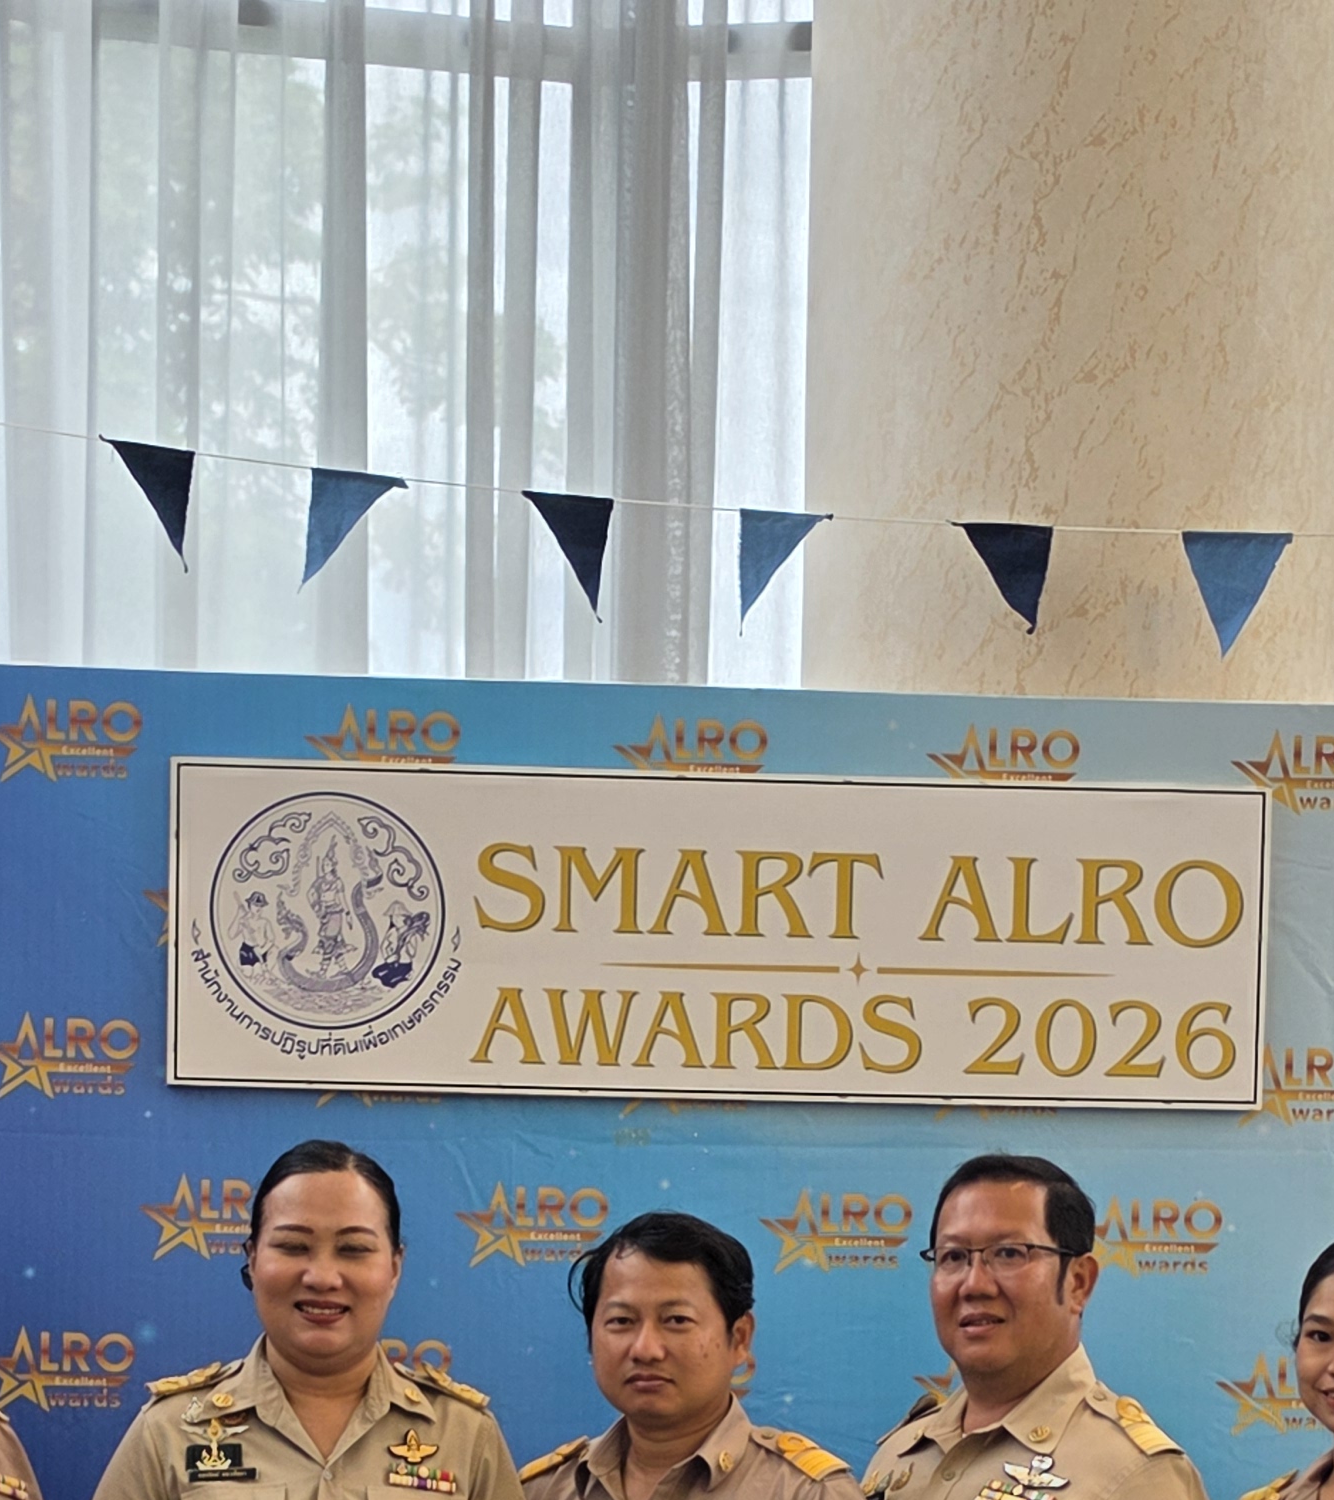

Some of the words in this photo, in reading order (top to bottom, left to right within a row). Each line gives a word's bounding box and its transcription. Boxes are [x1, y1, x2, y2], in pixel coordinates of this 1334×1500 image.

[61, 746, 115, 756] Excellent
[309, 704, 460, 753] ALRO
[617, 714, 768, 762] ALRO
[931, 723, 1080, 770] ALRO
[473, 842, 884, 938] SMART
[917, 855, 1245, 949] ALRO
[191, 948, 462, 1060] สำนักงานการปฏิรูปที่ดินเพื่อเกษตรกรรม
[470, 986, 922, 1074] AWARDS
[963, 997, 1236, 1080] 2026
[58, 1063, 112, 1074] Excellent
[145, 1173, 252, 1220] ALR
[462, 1180, 608, 1228] ALRO
[766, 1189, 913, 1235] ALRO
[1095, 1196, 1223, 1240] ALRO
[529, 1231, 581, 1241] Excellent
[834, 1237, 886, 1247] Excellent
[1144, 1243, 1196, 1253] Excellent
[54, 1376, 108, 1387] Excellent
